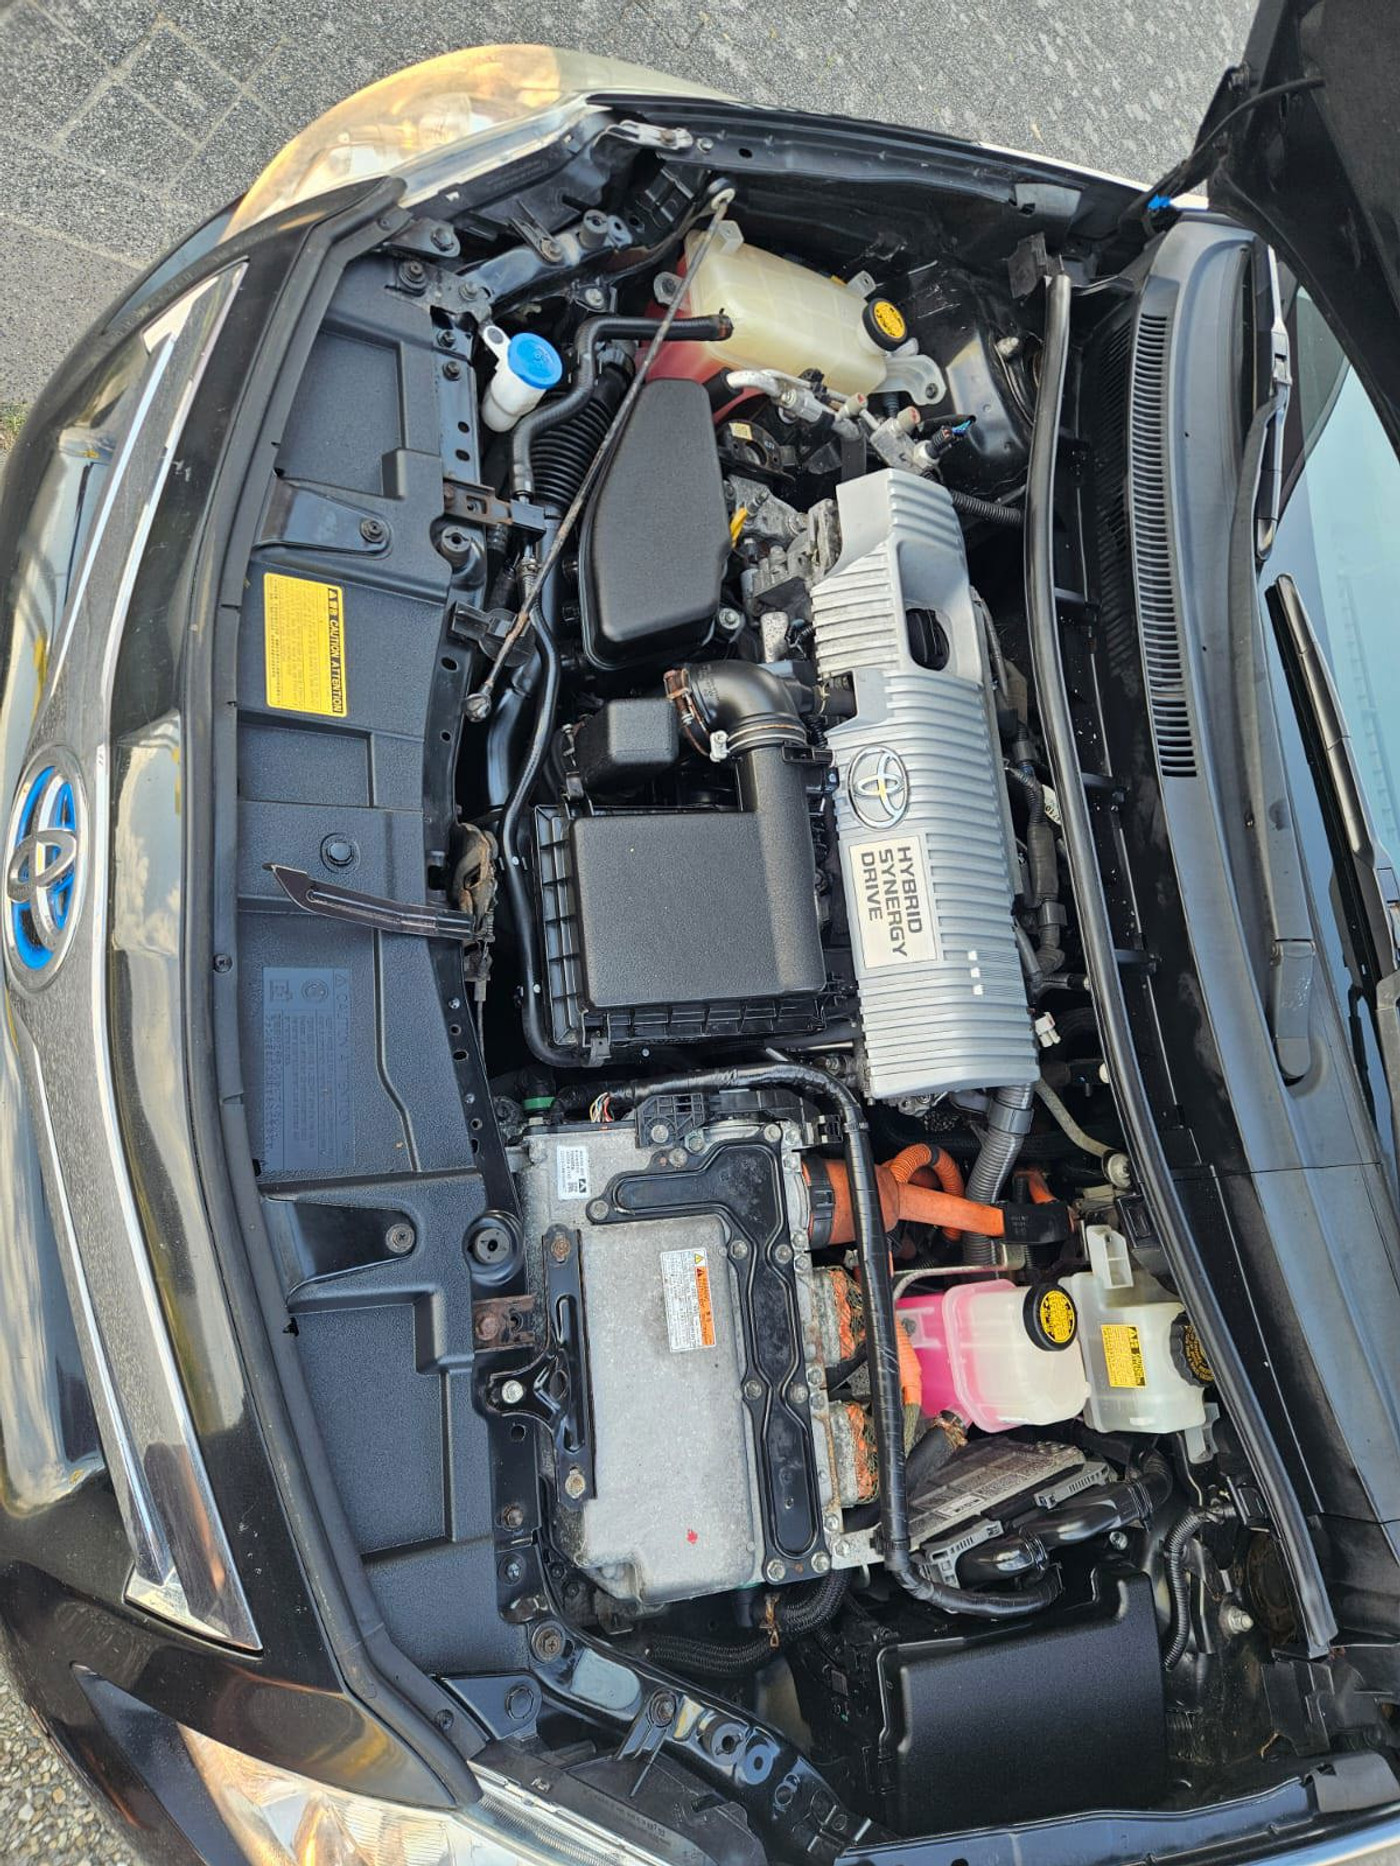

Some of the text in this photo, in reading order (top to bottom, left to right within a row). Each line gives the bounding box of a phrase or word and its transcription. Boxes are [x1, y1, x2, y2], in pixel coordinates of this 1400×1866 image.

[329, 619, 341, 658] CAUTION
[331, 660, 343, 713] ATTENTION
[861, 851, 883, 921] DRIVE
[879, 848, 908, 957] SYNERGY
[897, 846, 923, 934] HYBRID
